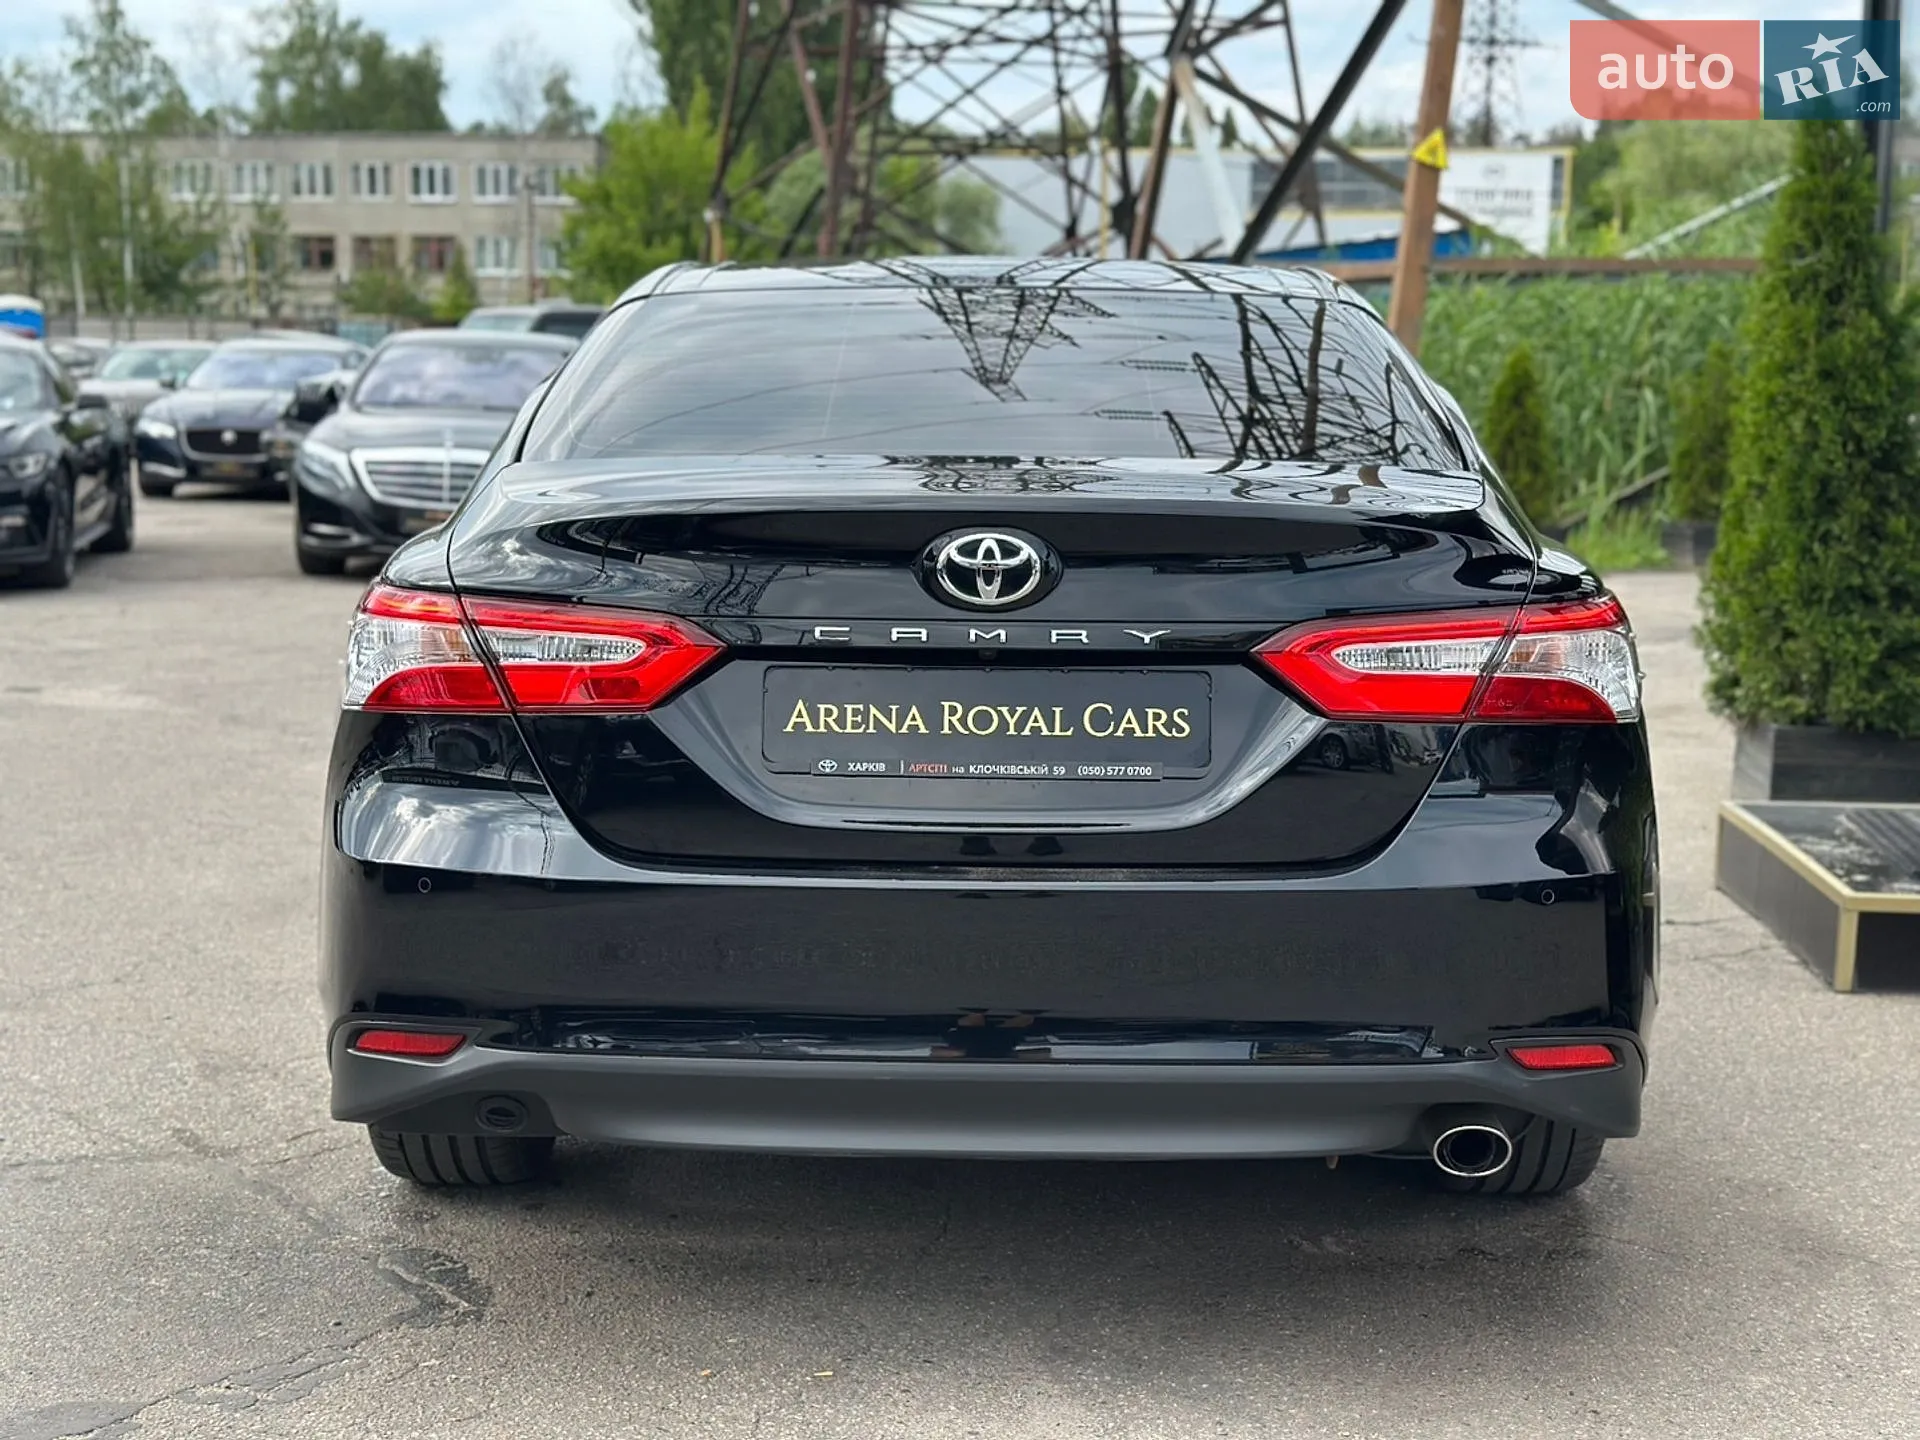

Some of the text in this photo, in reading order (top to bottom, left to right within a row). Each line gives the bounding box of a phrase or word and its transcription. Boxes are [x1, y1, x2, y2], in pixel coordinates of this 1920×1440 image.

[814, 626, 1172, 644] CAMRY
[847, 762, 886, 772] ХАРКІВ
[1053, 766, 1066, 776] 59
[1077, 765, 1105, 777] (050)
[1106, 766, 1125, 776] 577
[1126, 766, 1153, 776] 0700
